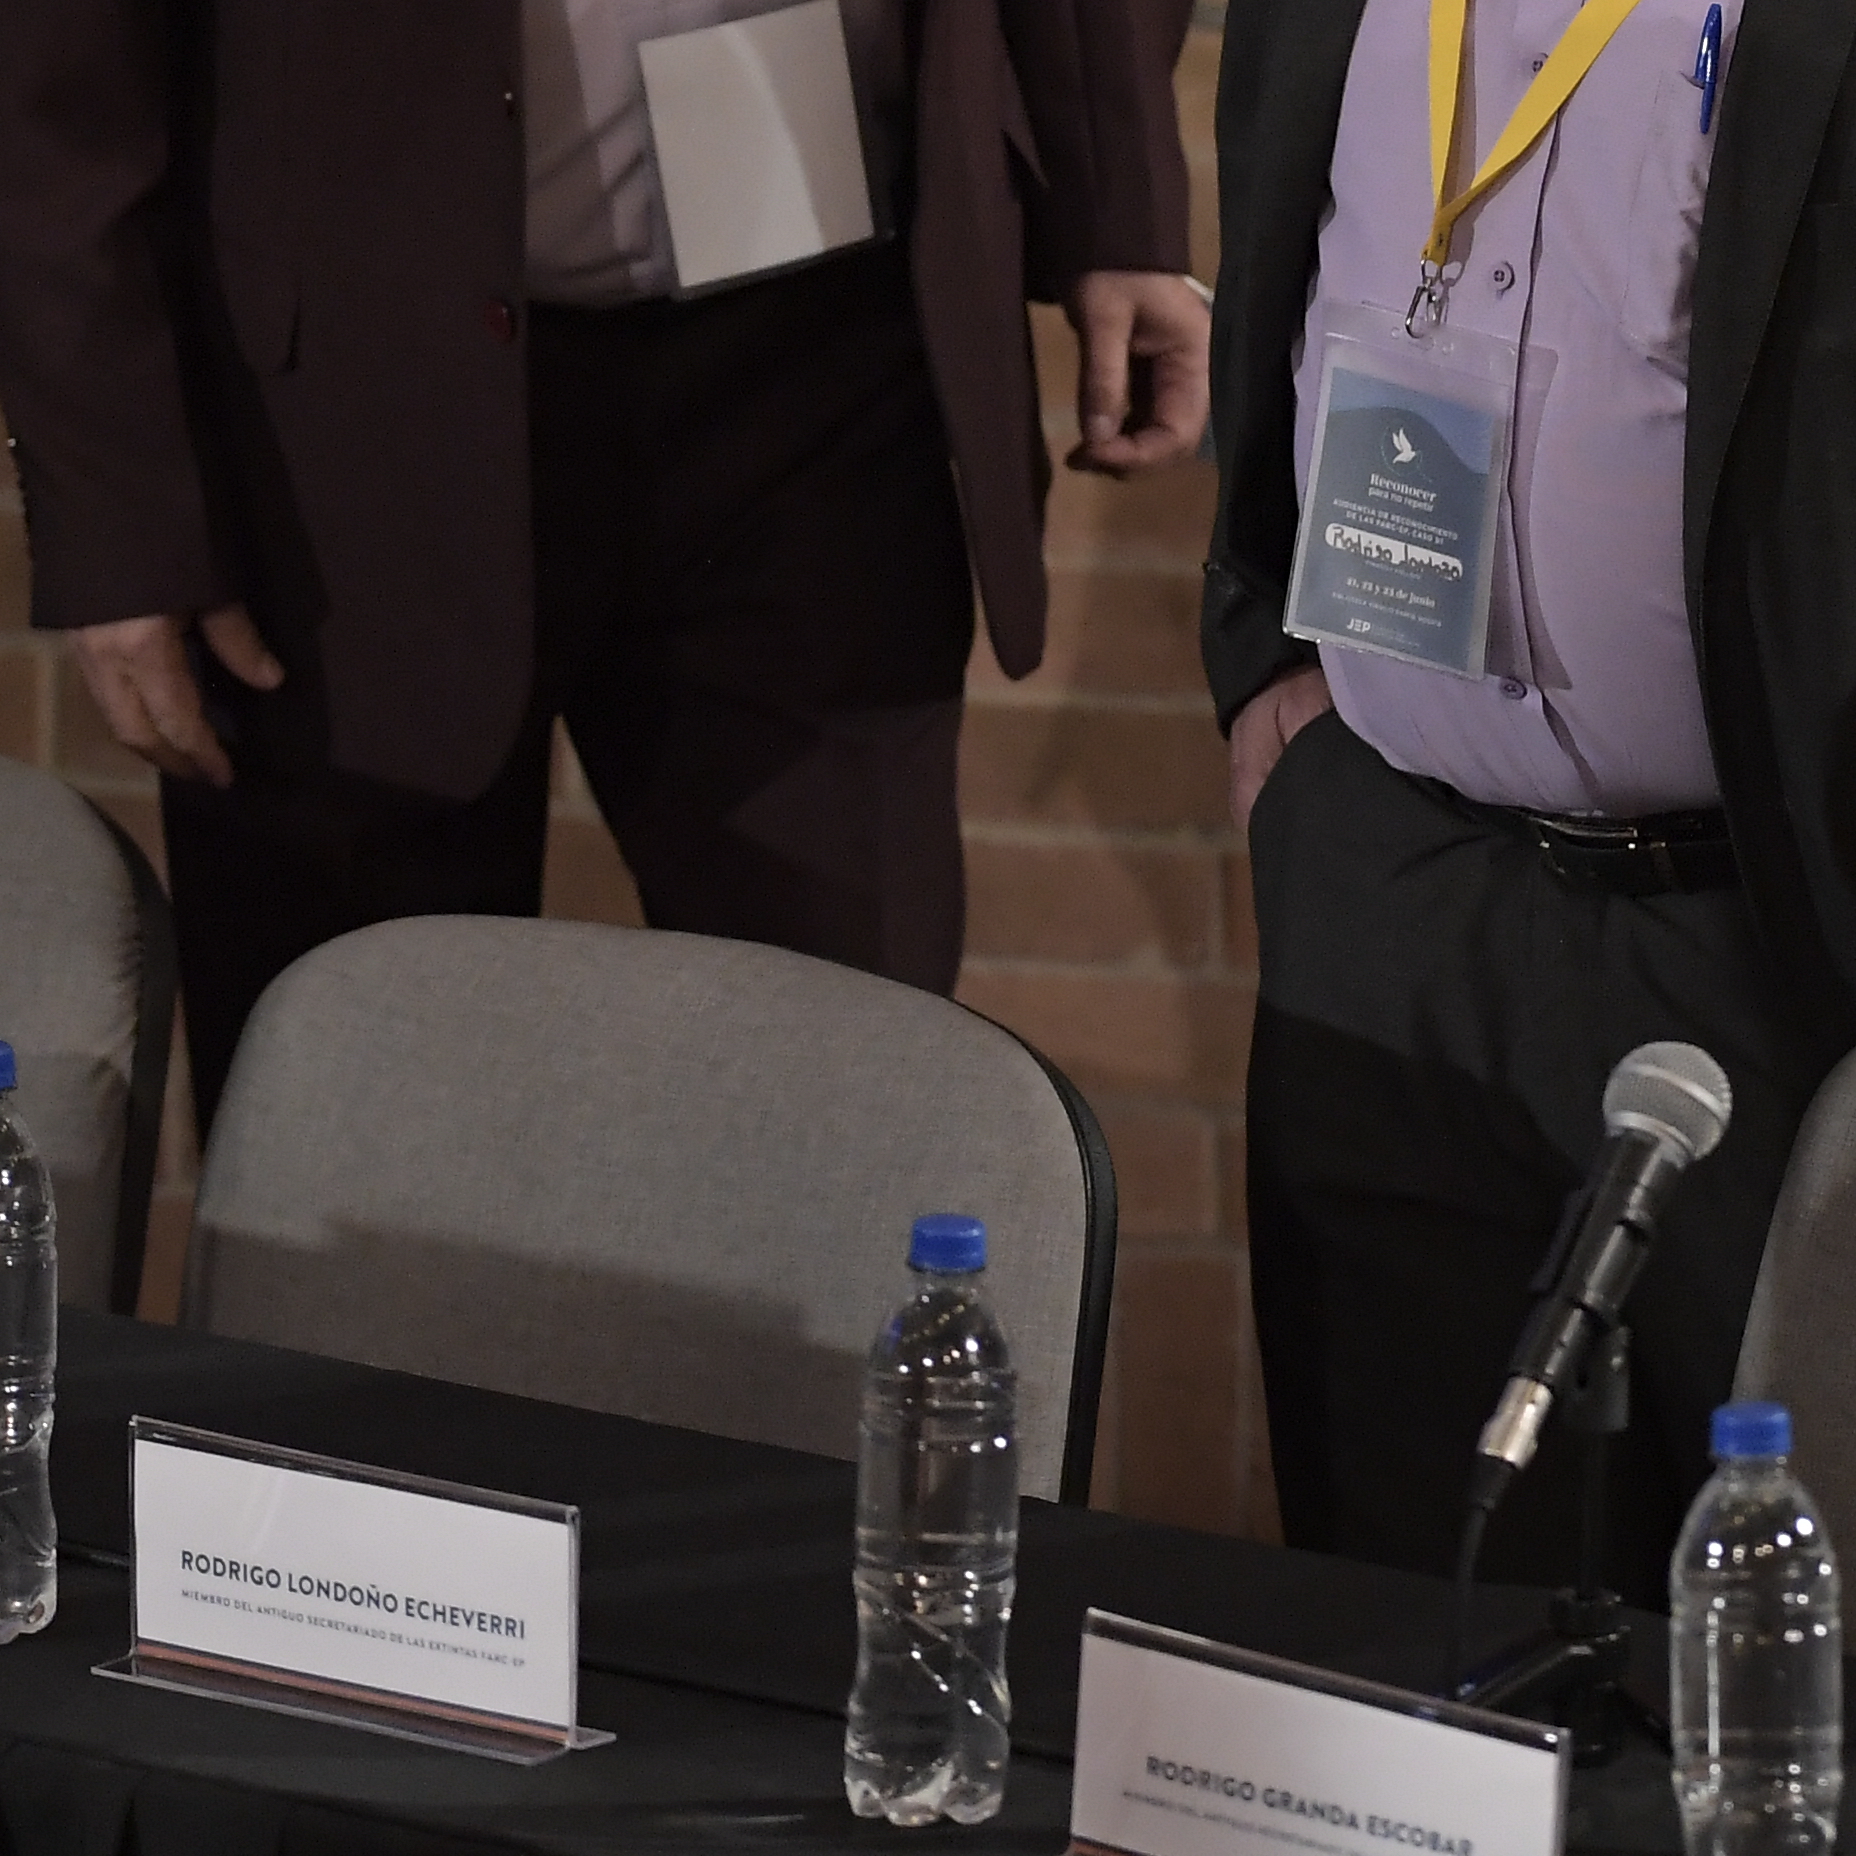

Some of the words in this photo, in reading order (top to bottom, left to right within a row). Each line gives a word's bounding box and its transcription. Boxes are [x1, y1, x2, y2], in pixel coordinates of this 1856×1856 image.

[1370, 473, 1437, 502] Reconocer
[1346, 618, 1371, 633] JEP
[181, 1550, 281, 1588] RODRIGO
[288, 1572, 398, 1613] LONDOÑO
[405, 1596, 525, 1640] ECHEVERRI
[181, 1589, 230, 1607] MIEMBRO
[234, 1600, 253, 1613] DEL
[257, 1606, 304, 1623] ANTIGUO
[307, 1615, 386, 1640] SECRETARIADO
[389, 1632, 403, 1644] DE
[406, 1636, 425, 1648] LAS
[429, 1640, 477, 1659] EXTINTAS
[1147, 1756, 1255, 1801] RODRIGO
[1262, 1788, 1359, 1830] GRANDA
[1366, 1814, 1474, 1856] ESCOBAR
